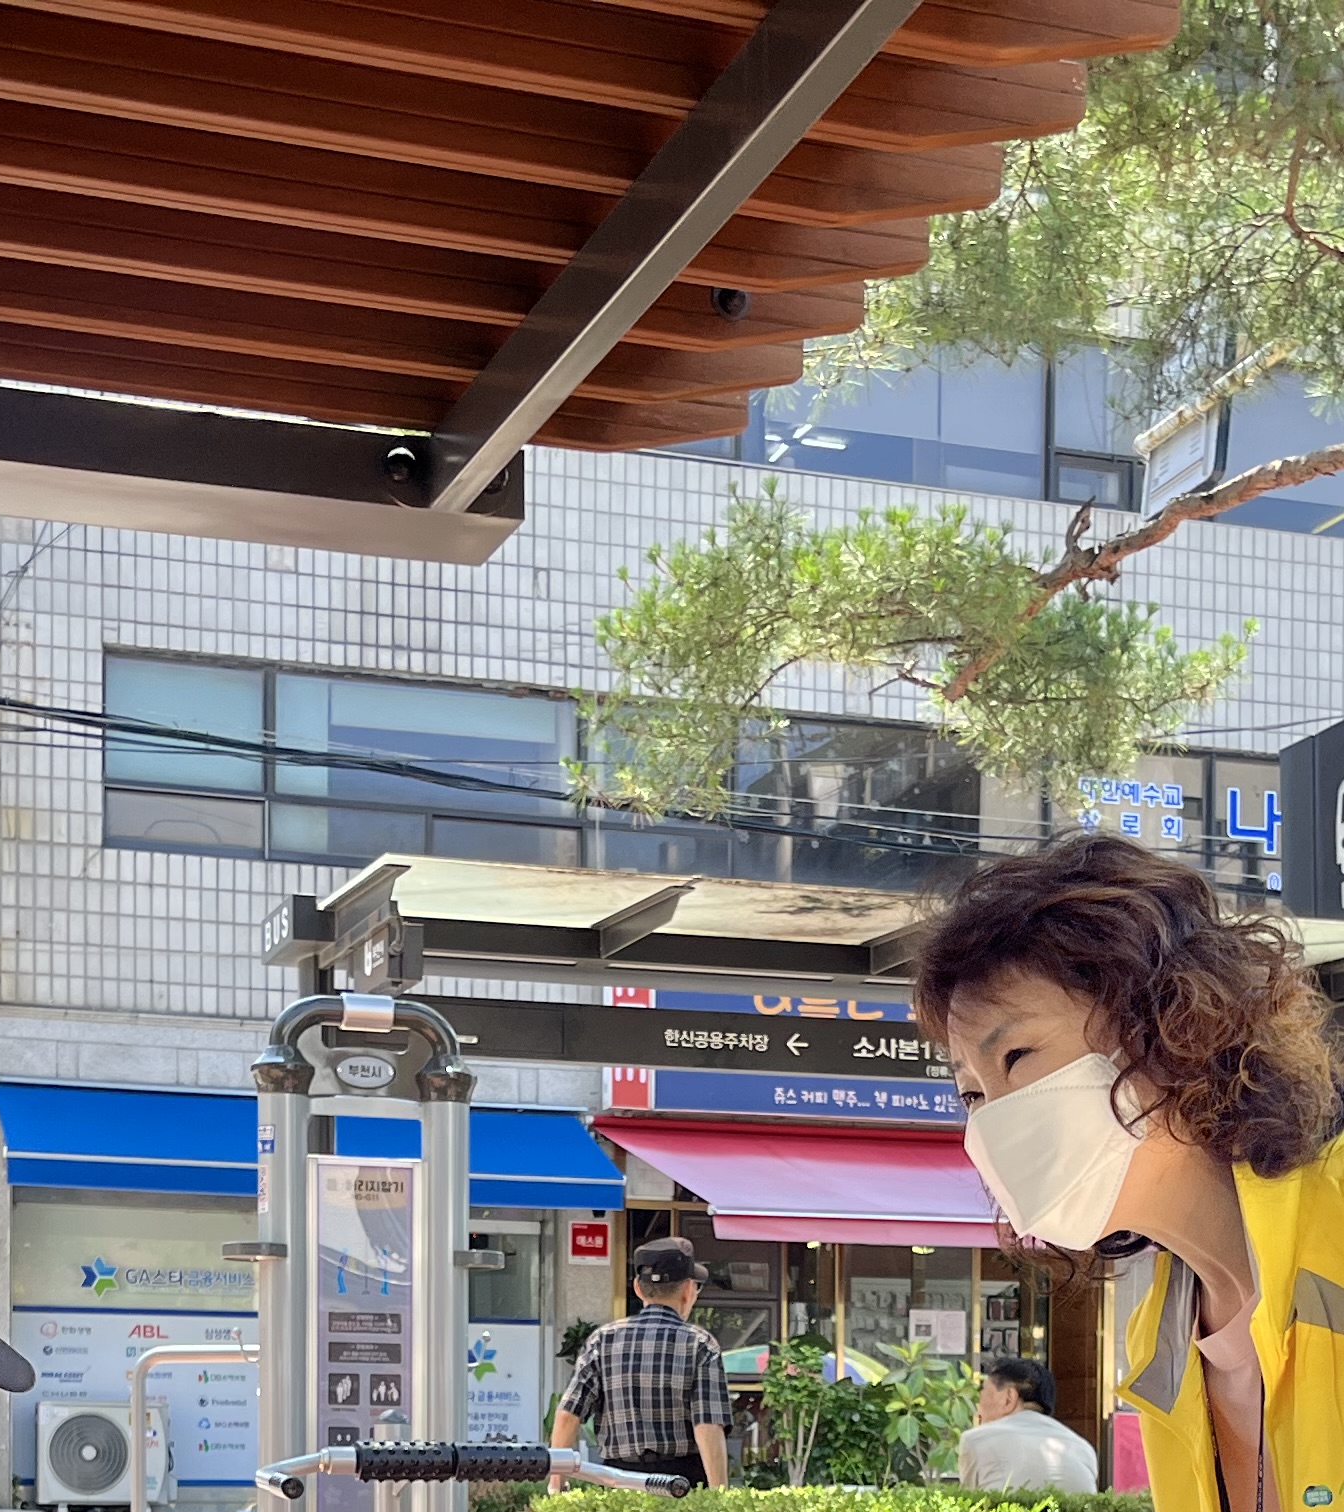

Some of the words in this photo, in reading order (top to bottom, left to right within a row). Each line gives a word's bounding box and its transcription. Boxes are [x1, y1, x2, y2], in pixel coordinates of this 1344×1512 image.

[265, 907, 288, 952] BUS
[664, 1029, 769, 1052] 한신공용주차장
[349, 1064, 381, 1078] 부천시
[774, 1087, 797, 1105] 쥬스
[801, 1089, 828, 1106] 커피
[891, 1093, 930, 1111] 피아노
[125, 1268, 184, 1286] GA스타
[187, 1271, 256, 1286] 금융서비스
[128, 1325, 169, 1339] ABL
[205, 1328, 242, 1340] 삼성생
